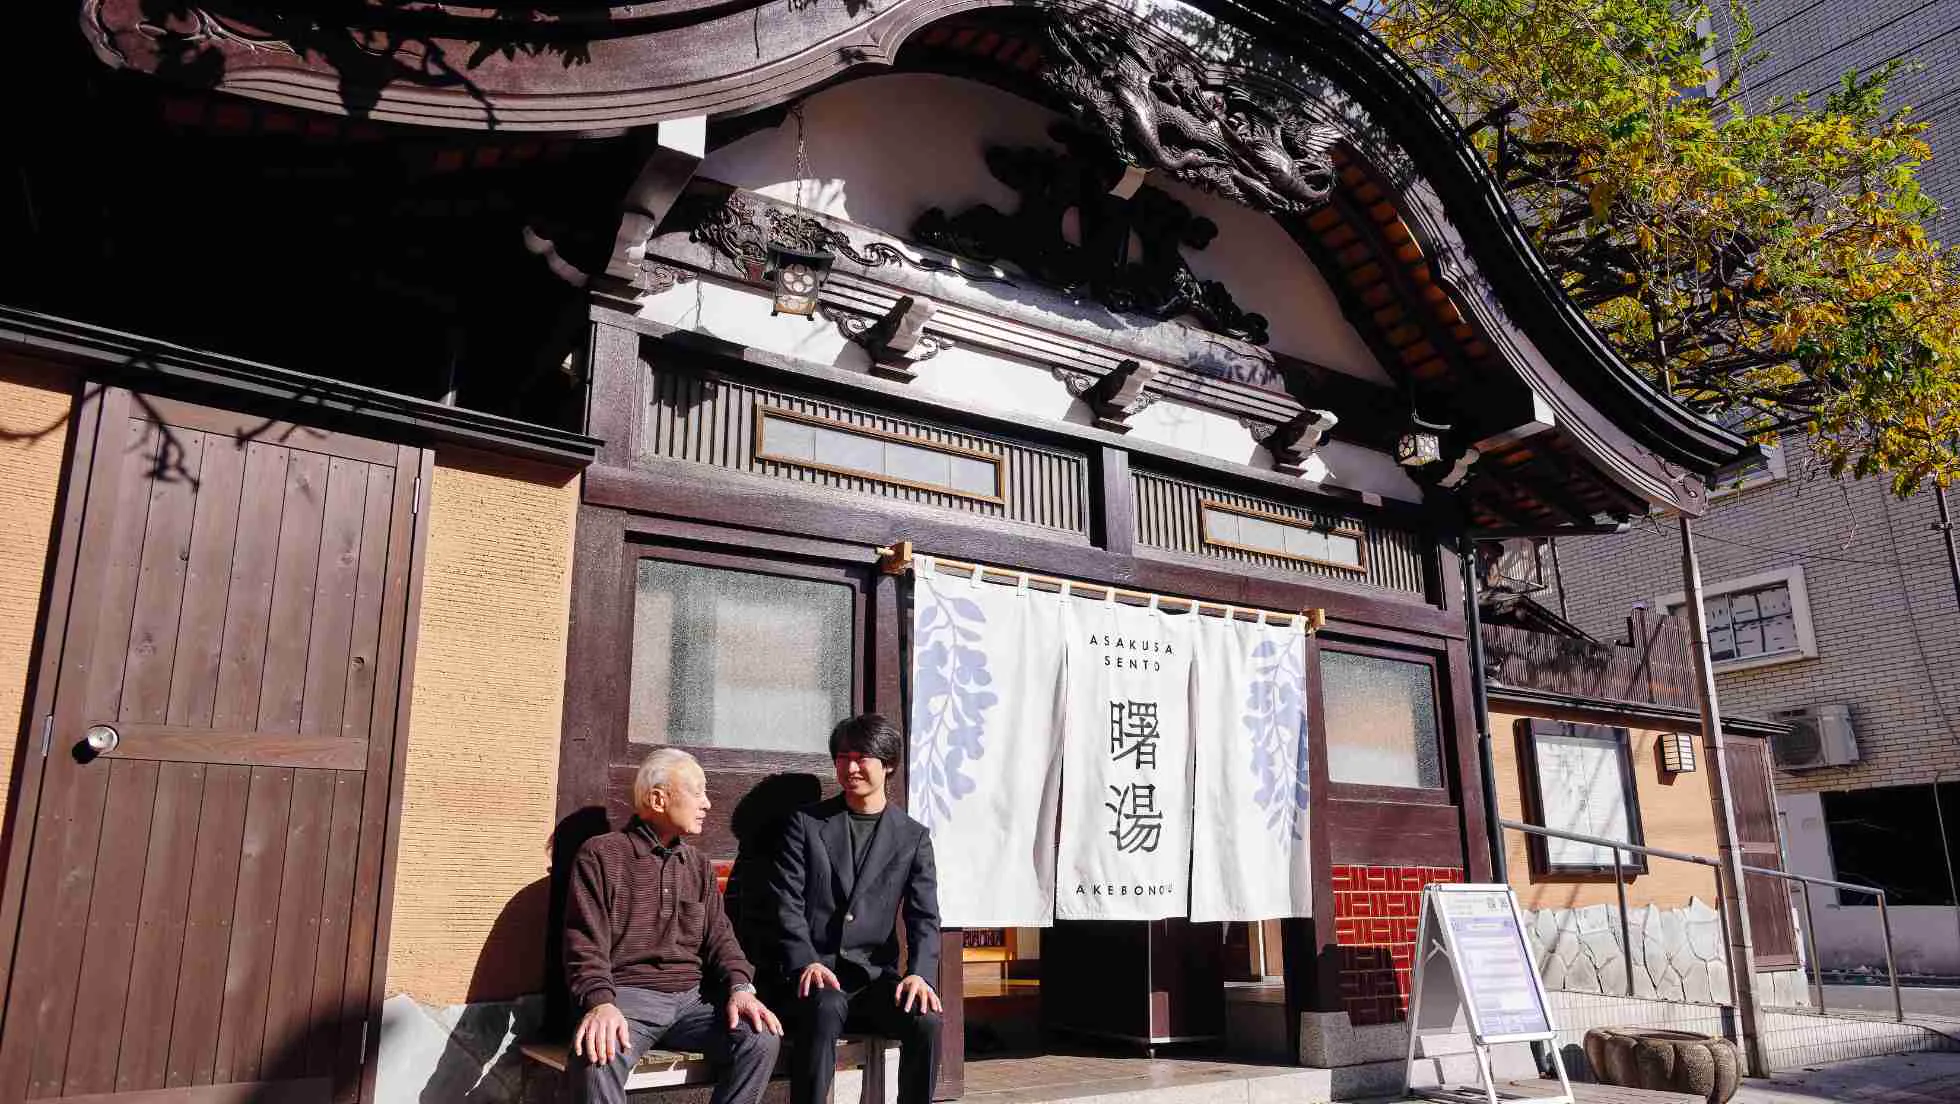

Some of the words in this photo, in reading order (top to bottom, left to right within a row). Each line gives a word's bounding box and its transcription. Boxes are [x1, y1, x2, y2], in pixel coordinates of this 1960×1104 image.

[1089, 634, 1173, 655] ASAKUSA
[1104, 655, 1160, 672] SENTO
[1105, 699, 1163, 854] 曙湯
